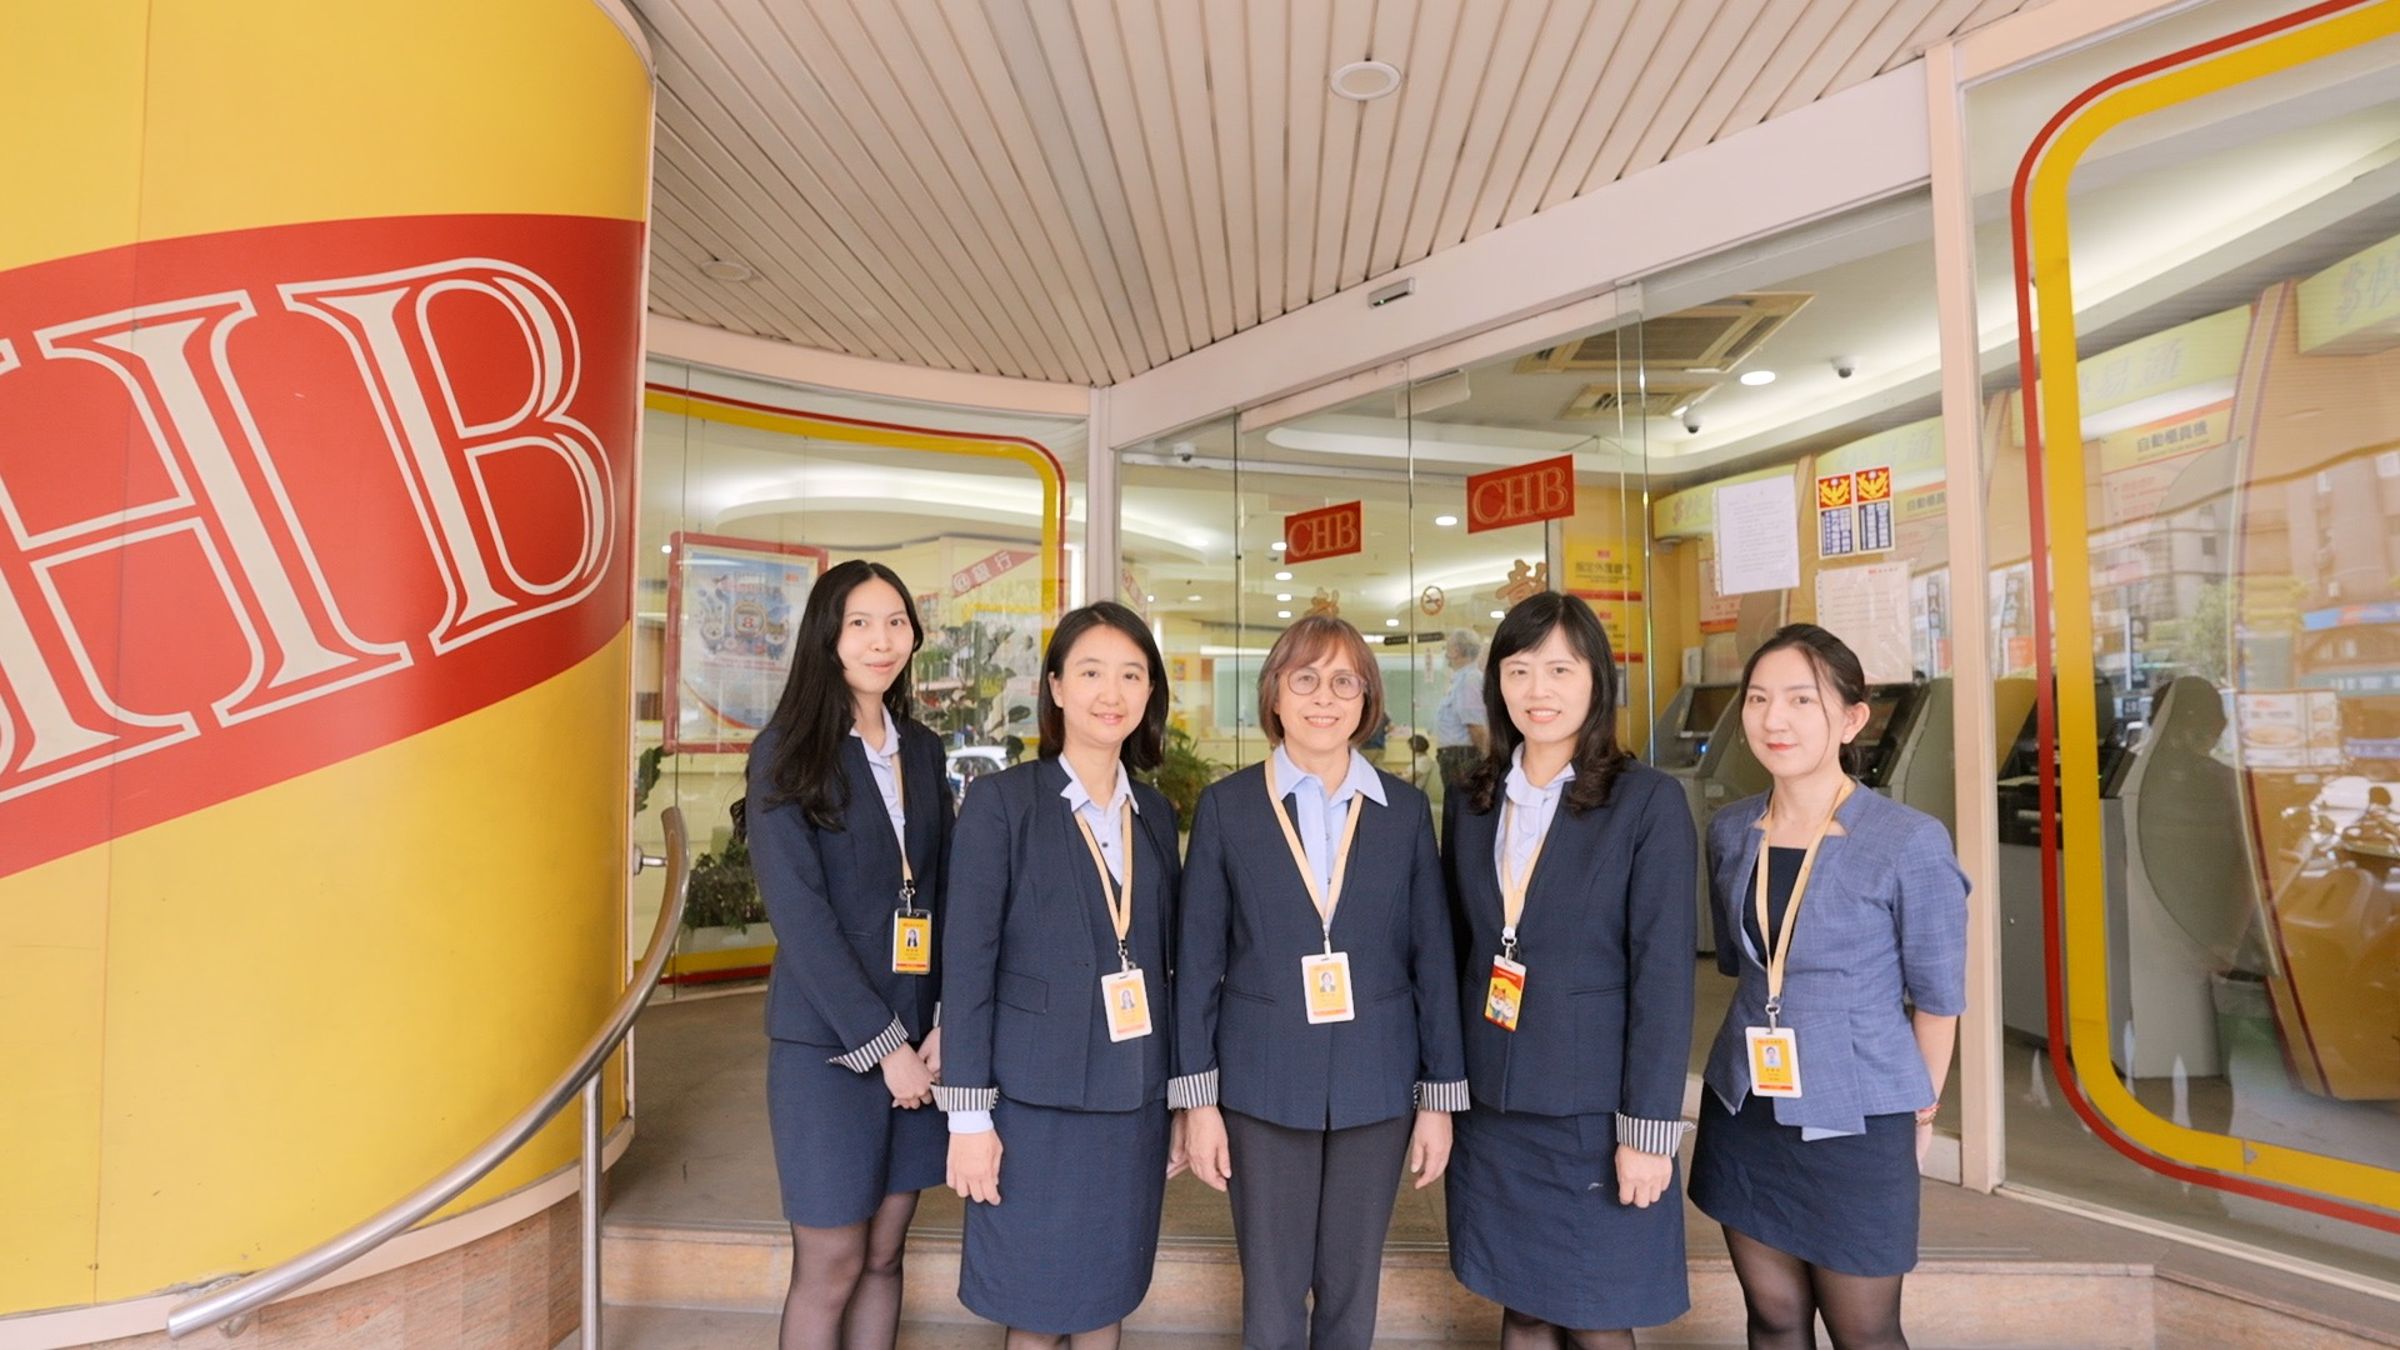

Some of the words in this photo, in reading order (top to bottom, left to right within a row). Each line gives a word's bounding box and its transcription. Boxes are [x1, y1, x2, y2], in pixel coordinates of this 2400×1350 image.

[1473, 466, 1569, 525] CHB
[0, 257, 615, 803] HB
[1288, 510, 1358, 557] CHB
